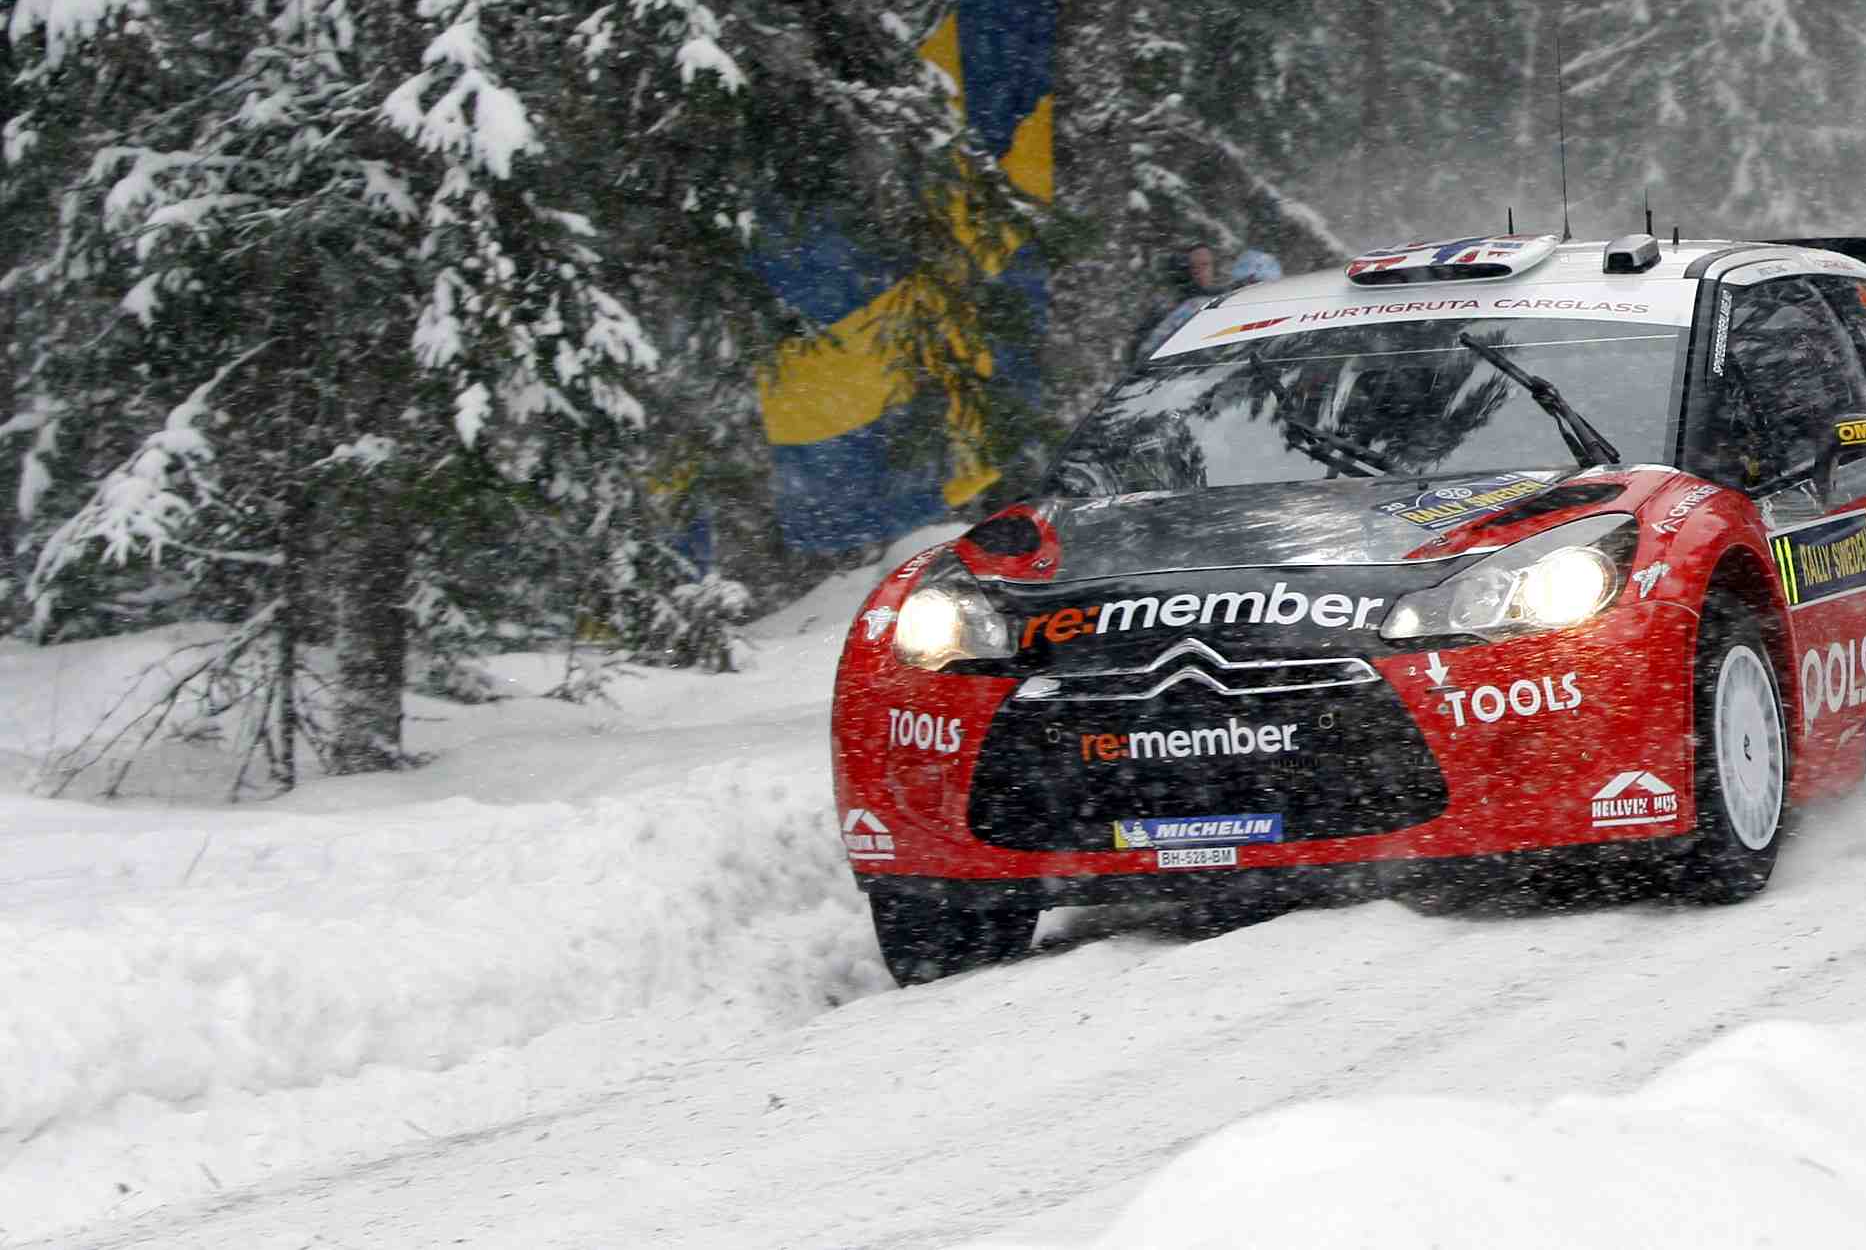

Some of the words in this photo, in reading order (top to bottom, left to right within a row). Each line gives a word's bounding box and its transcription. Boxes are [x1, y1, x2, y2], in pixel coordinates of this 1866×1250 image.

[1299, 299, 1479, 323] HURTIGRUTA
[1493, 298, 1650, 315] CARGLASS
[1402, 502, 1469, 523] RALLY
[1799, 544, 1833, 587] RALLY
[1020, 581, 1386, 650] re:member
[1444, 671, 1583, 728] TOOLS
[888, 707, 962, 754] TOOLS
[1081, 717, 1300, 763] re:member
[1154, 819, 1273, 839] MICHELIN
